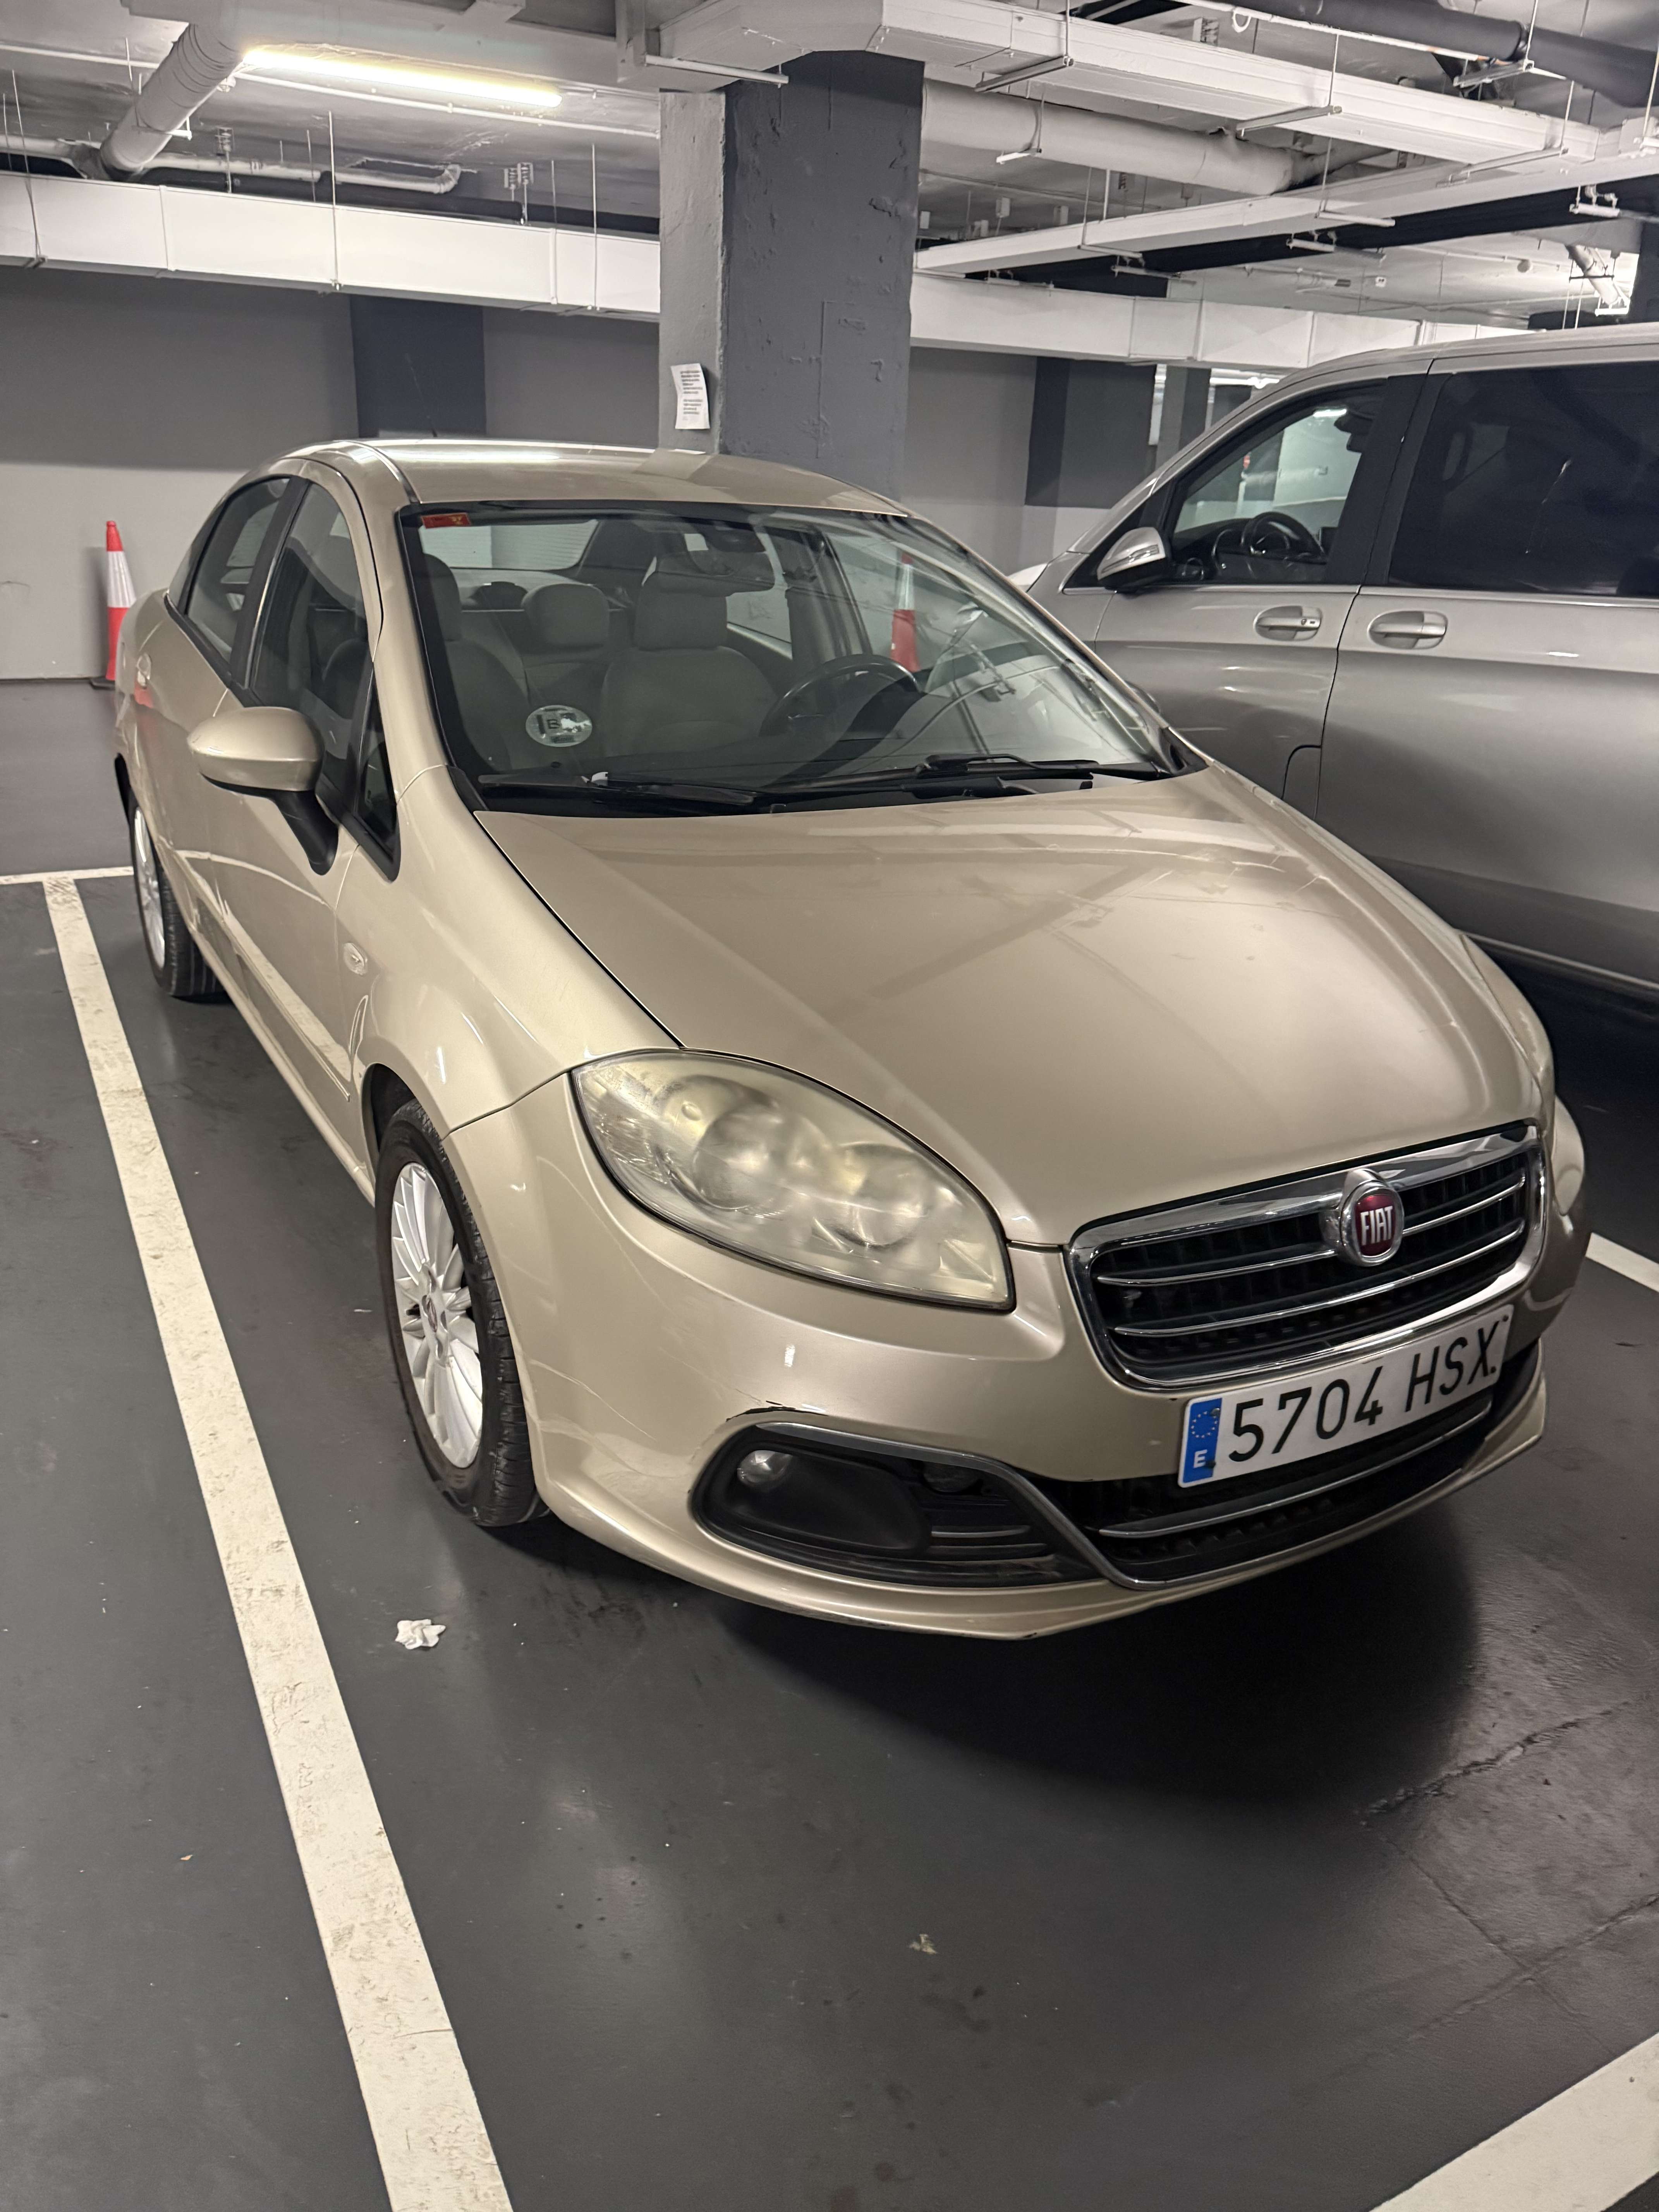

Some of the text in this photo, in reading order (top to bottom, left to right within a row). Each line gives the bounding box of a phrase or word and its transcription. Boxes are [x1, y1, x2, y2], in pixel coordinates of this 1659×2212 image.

[547, 719, 560, 729] B
[1360, 1206, 1393, 1246] FIAT
[1229, 1321, 1499, 1462] 5704 HSX
[1194, 1449, 1207, 1468] E
